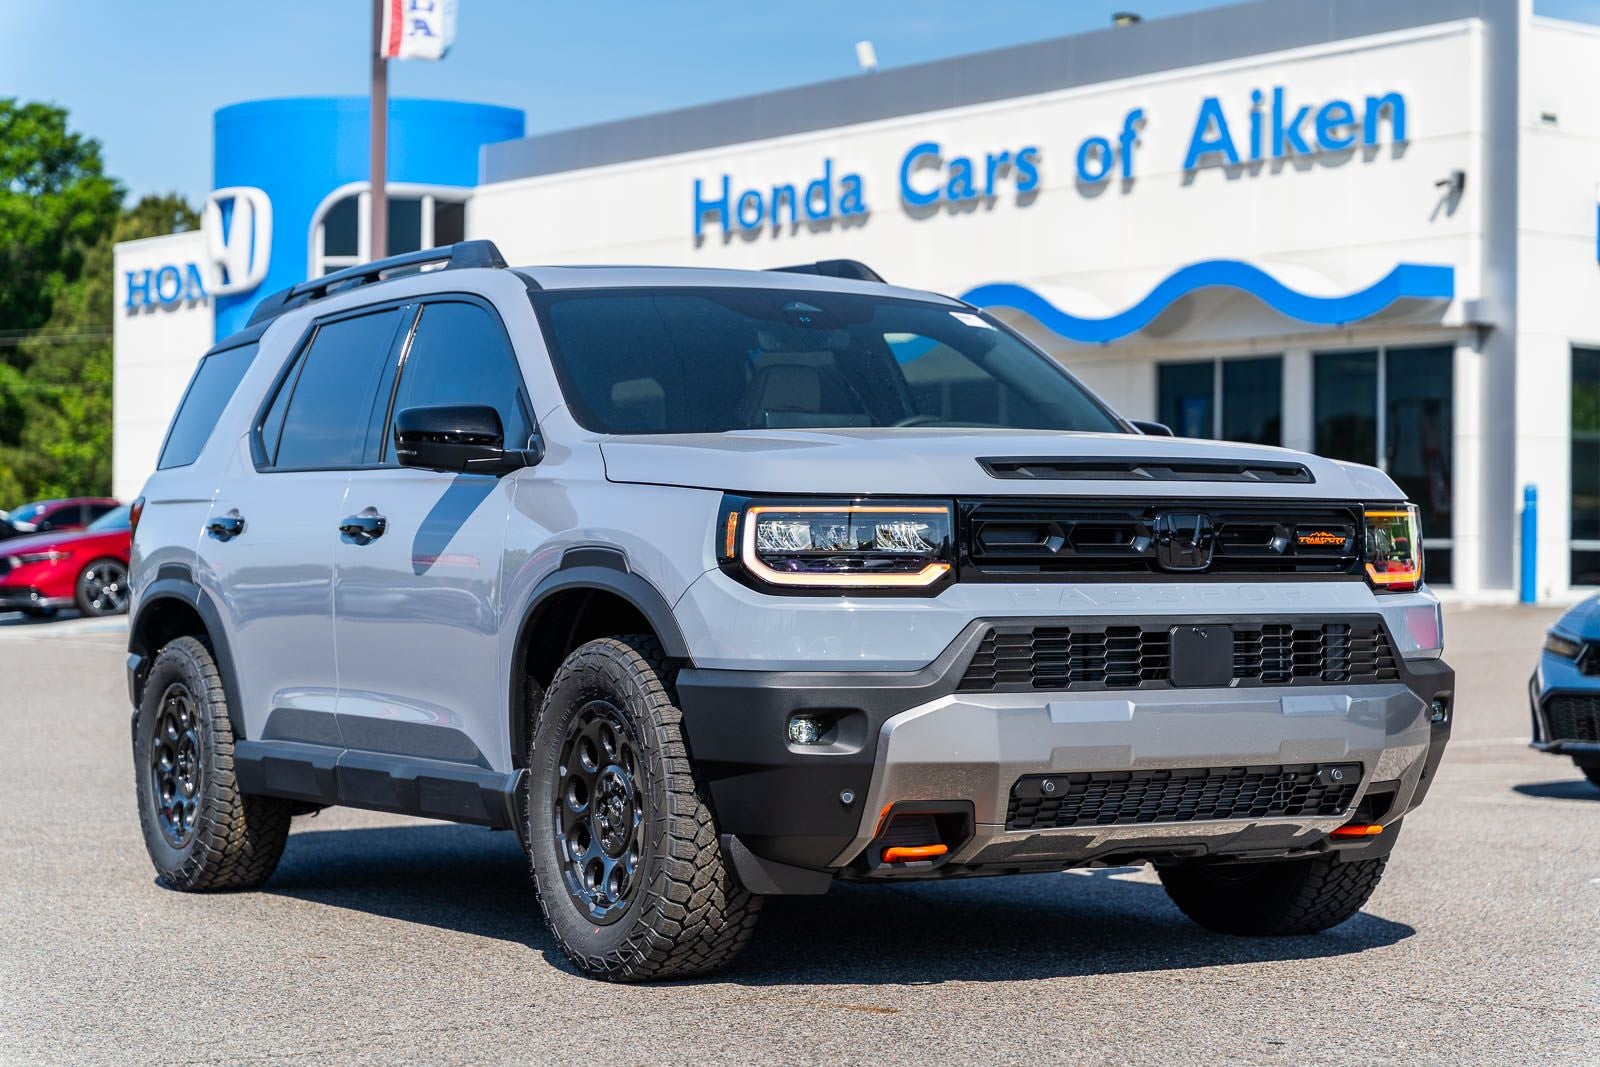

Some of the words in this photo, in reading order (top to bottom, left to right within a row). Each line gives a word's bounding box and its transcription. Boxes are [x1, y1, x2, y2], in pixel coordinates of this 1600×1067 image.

[694, 160, 867, 237] Honda
[900, 143, 1040, 207] Cars
[1077, 109, 1145, 184] of
[1184, 86, 1407, 171] Aiken
